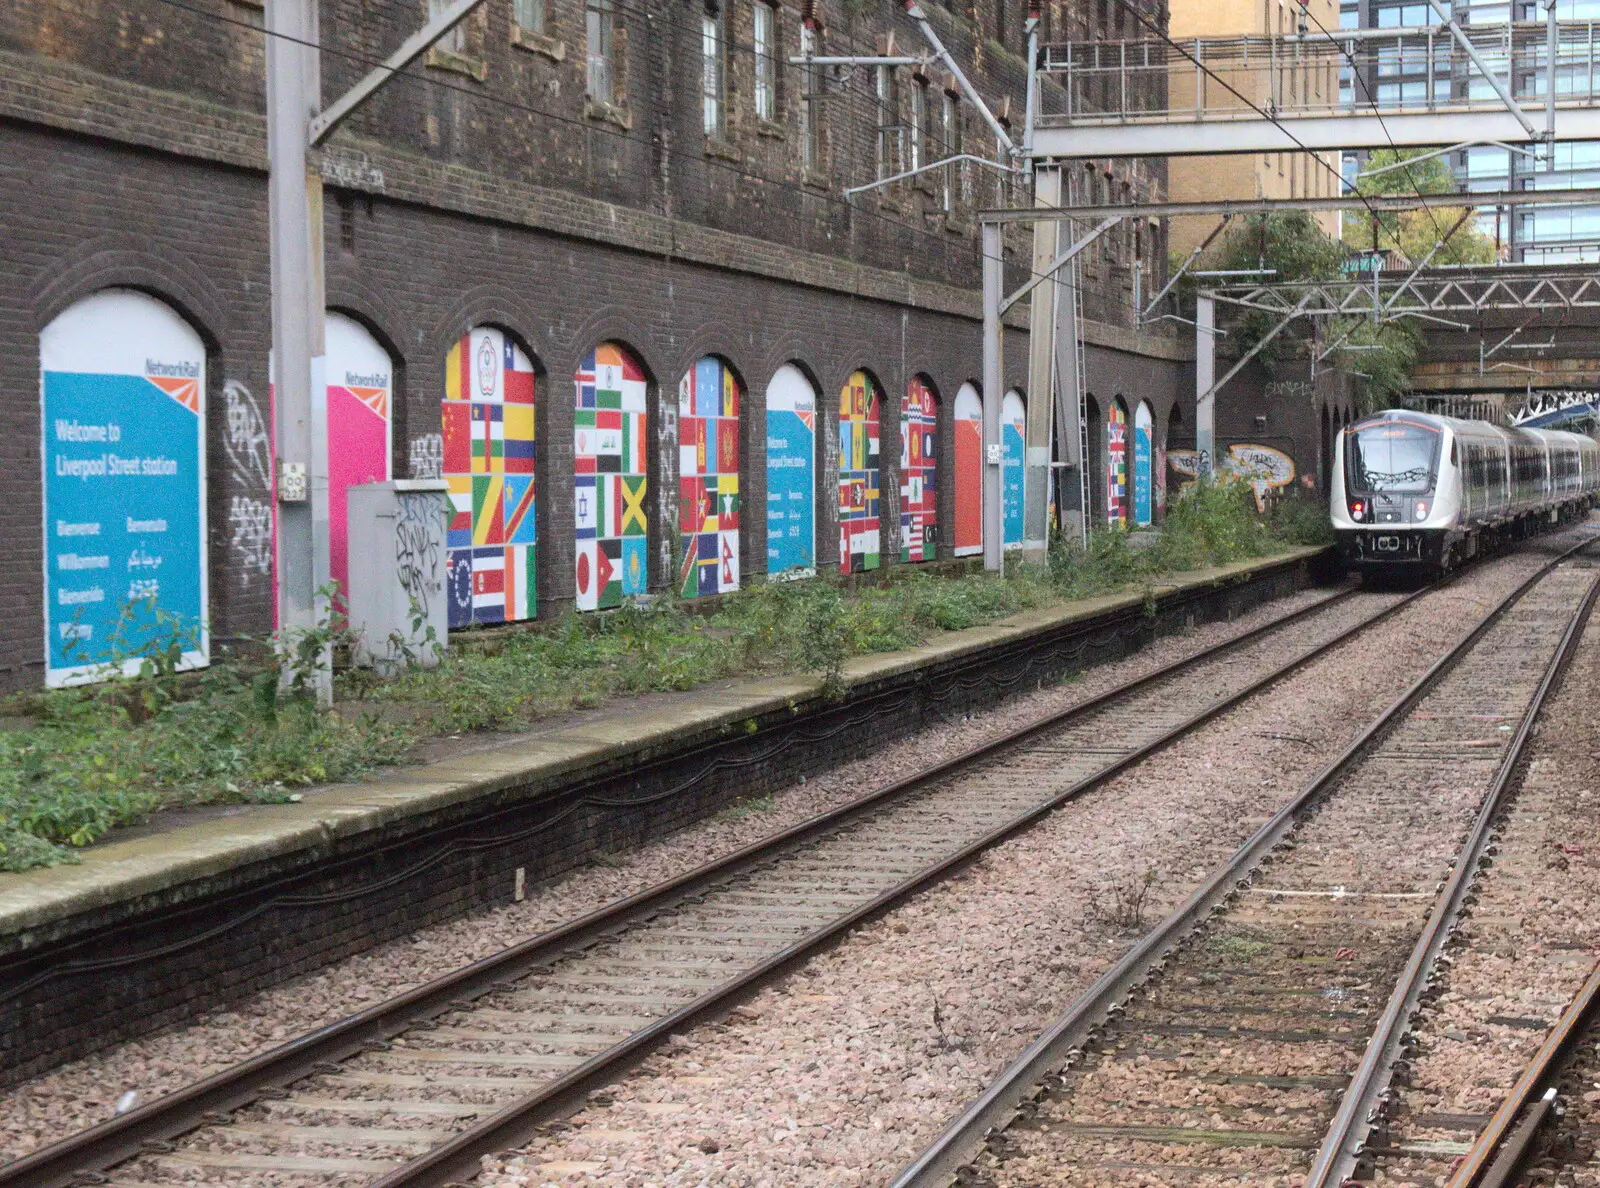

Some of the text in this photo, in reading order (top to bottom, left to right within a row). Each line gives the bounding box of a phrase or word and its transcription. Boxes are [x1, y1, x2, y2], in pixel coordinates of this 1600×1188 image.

[55, 419, 121, 442] Welcome to
[56, 453, 177, 481] Liverpool Street station
